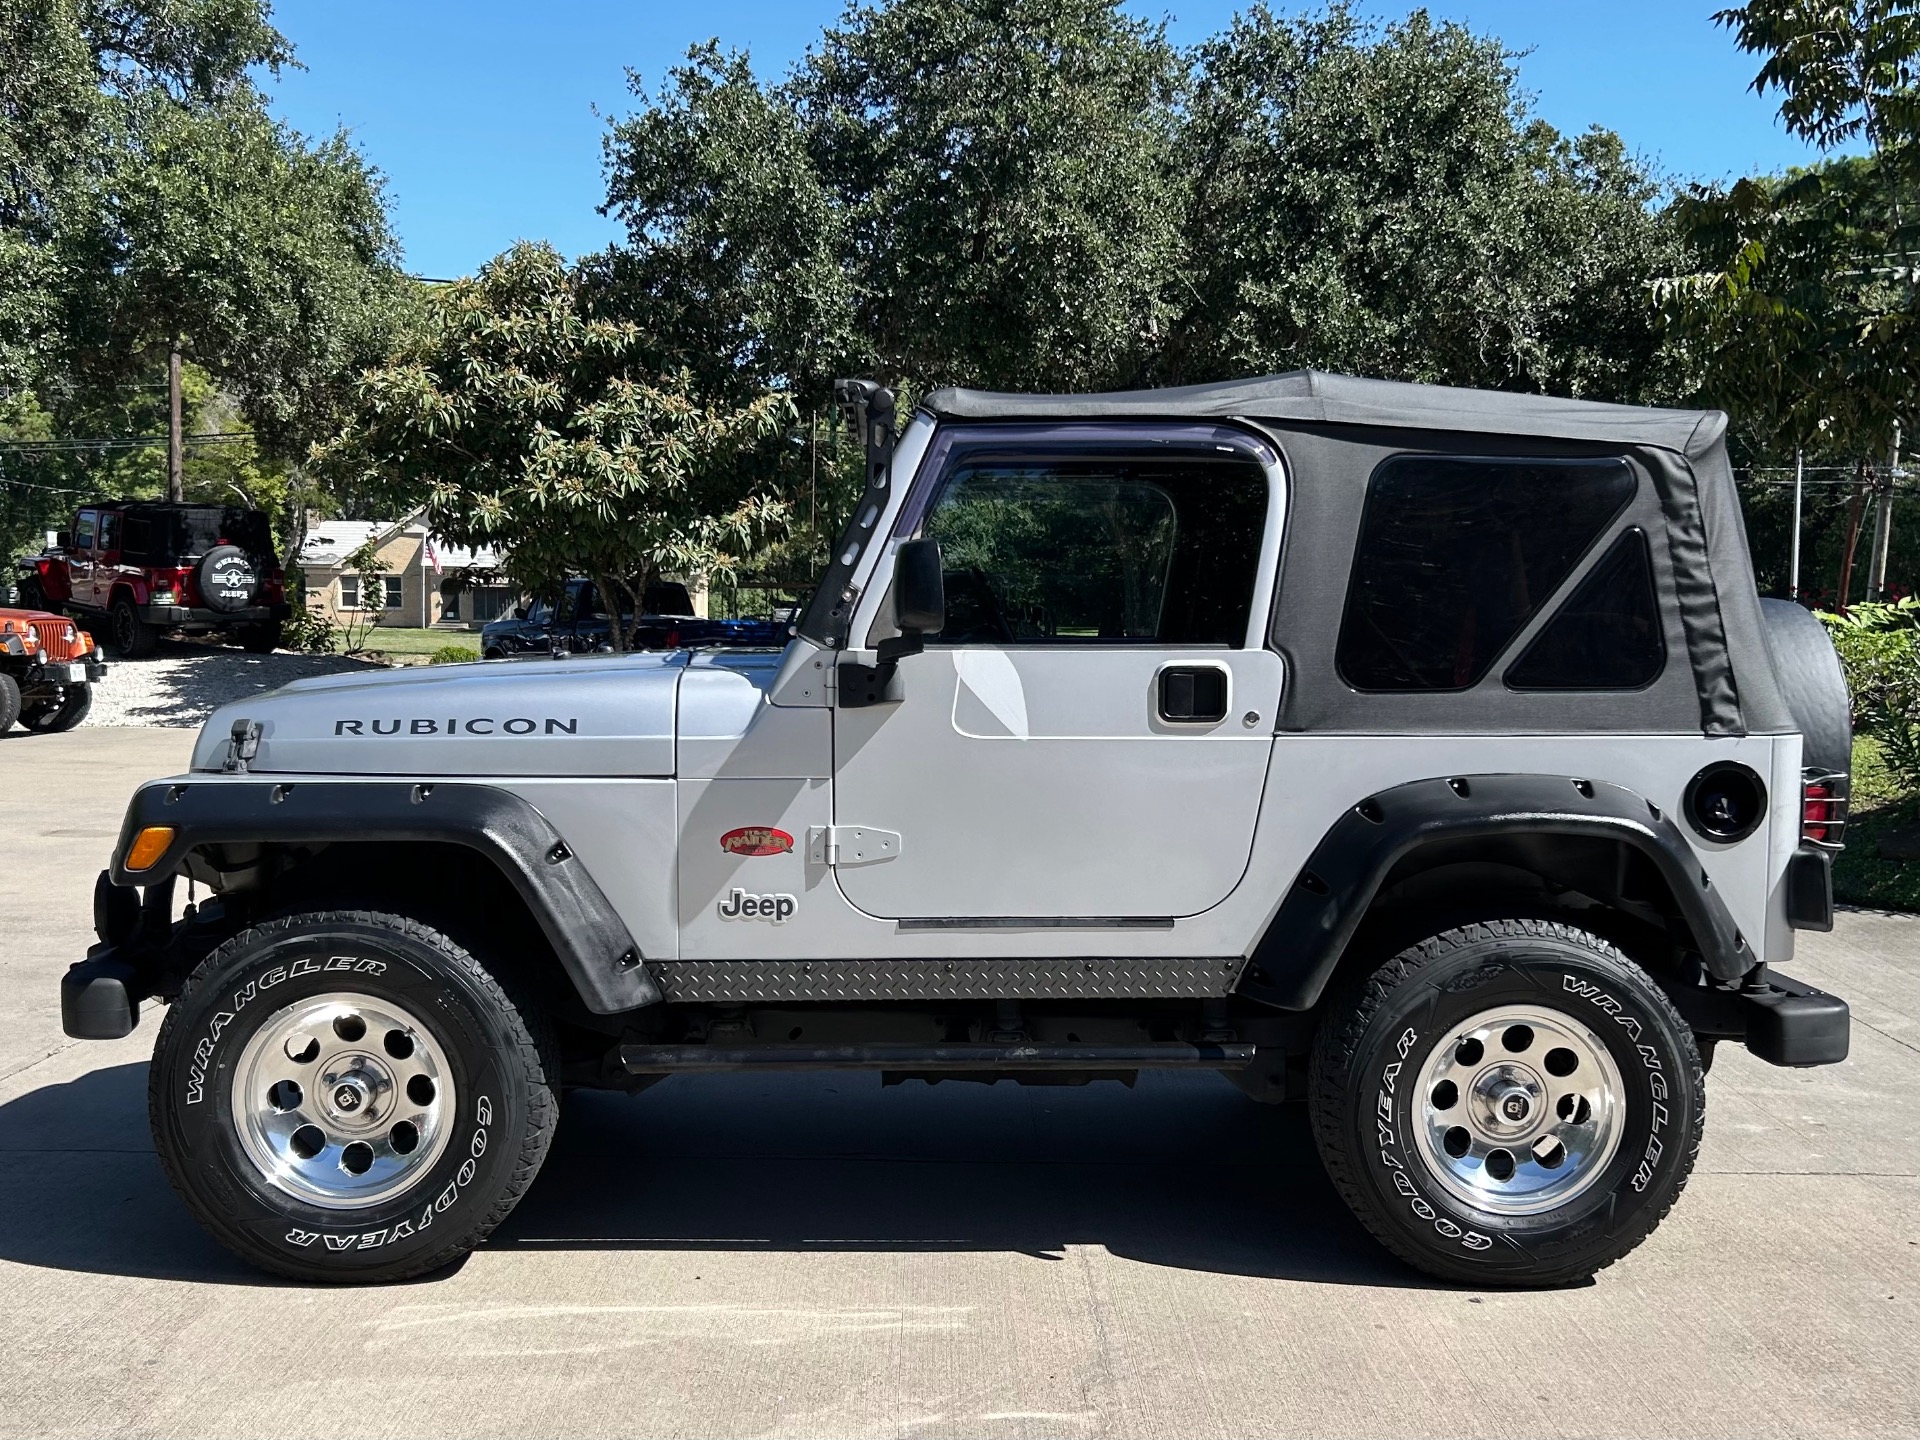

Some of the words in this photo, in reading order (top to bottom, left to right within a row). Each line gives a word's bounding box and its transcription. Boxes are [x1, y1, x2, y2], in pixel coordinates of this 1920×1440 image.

[215, 557, 252, 570] SELECT
[334, 718, 578, 735] RUBICON
[722, 893, 793, 921] Jeep
[186, 956, 387, 1105] WRANGLER
[1563, 974, 1669, 1192] WRANGLER
[285, 1095, 493, 1252] GOODYEAR
[1374, 1027, 1493, 1250] GOODYEAR
